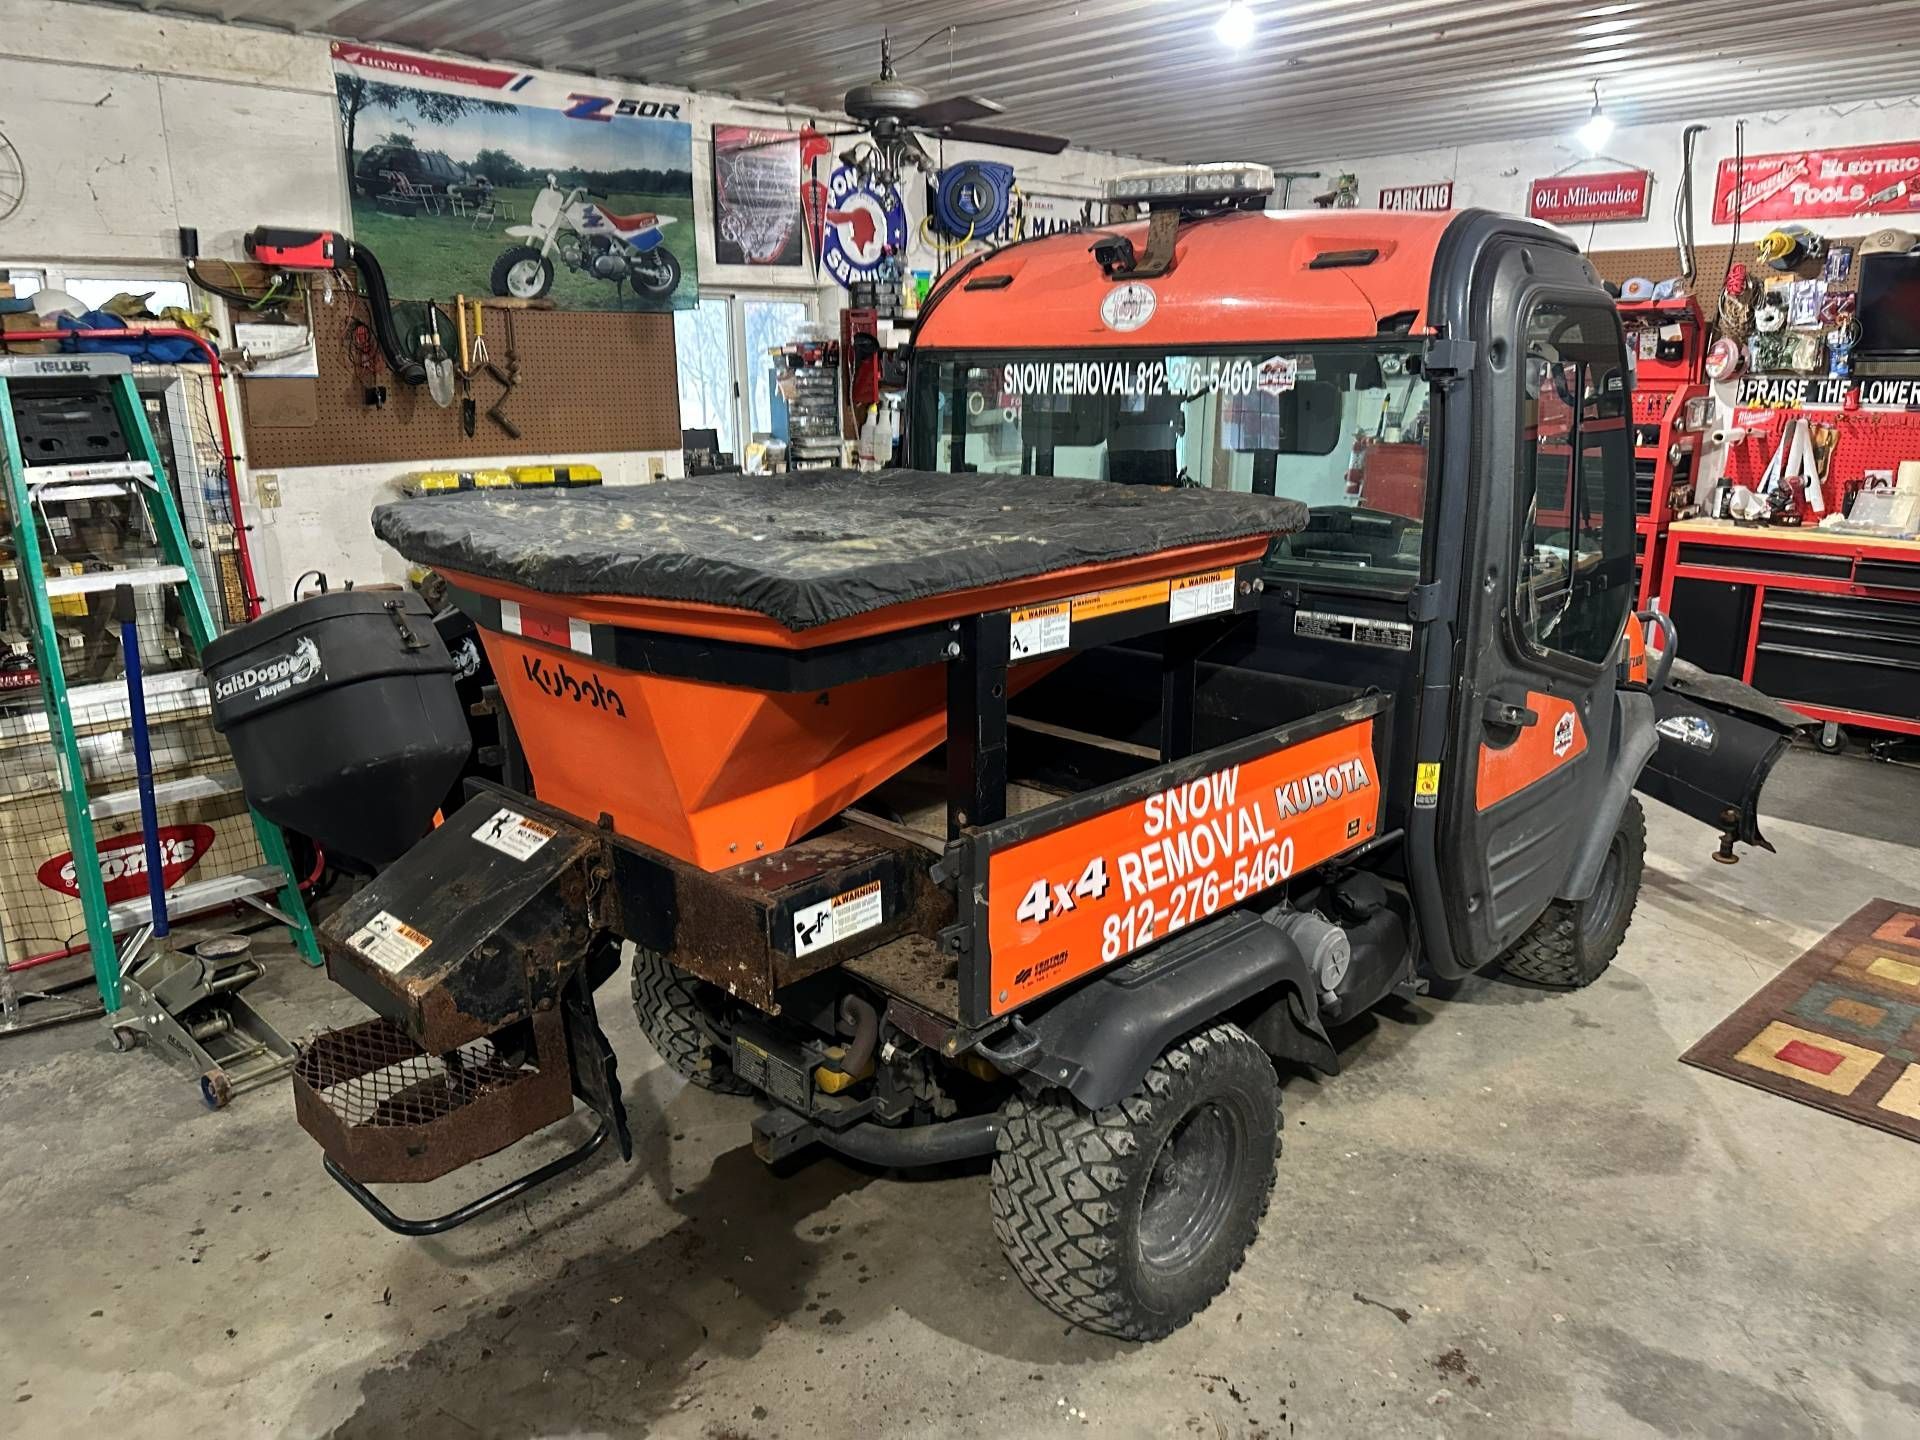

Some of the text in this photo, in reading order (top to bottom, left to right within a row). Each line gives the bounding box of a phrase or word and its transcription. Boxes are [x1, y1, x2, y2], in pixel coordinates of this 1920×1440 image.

[360, 56, 421, 75] HONDA
[1820, 157, 1919, 180] ELECTRIC
[1383, 184, 1449, 211] PARKING
[1535, 184, 1638, 210] Old Milwaukee
[1790, 183, 1865, 206] TOOLS
[35, 361, 91, 373] KELLER
[1003, 361, 1252, 395] SNOW REMOVAL 812-276-5460
[1746, 380, 1809, 402] PRAISE
[1817, 380, 1850, 402] THE
[1189, 572, 1220, 586] WARNING
[1028, 606, 1060, 619] WARNING
[259, 679, 291, 699] Buyers
[522, 655, 627, 718] Kubota
[1274, 758, 1370, 819] KUBOTA
[1144, 765, 1240, 837] SNOW
[1117, 801, 1275, 901] REMOVAL
[842, 881, 880, 904] WARNING
[1016, 857, 1109, 924] 4x4
[1102, 837, 1294, 962] 812-276-5460
